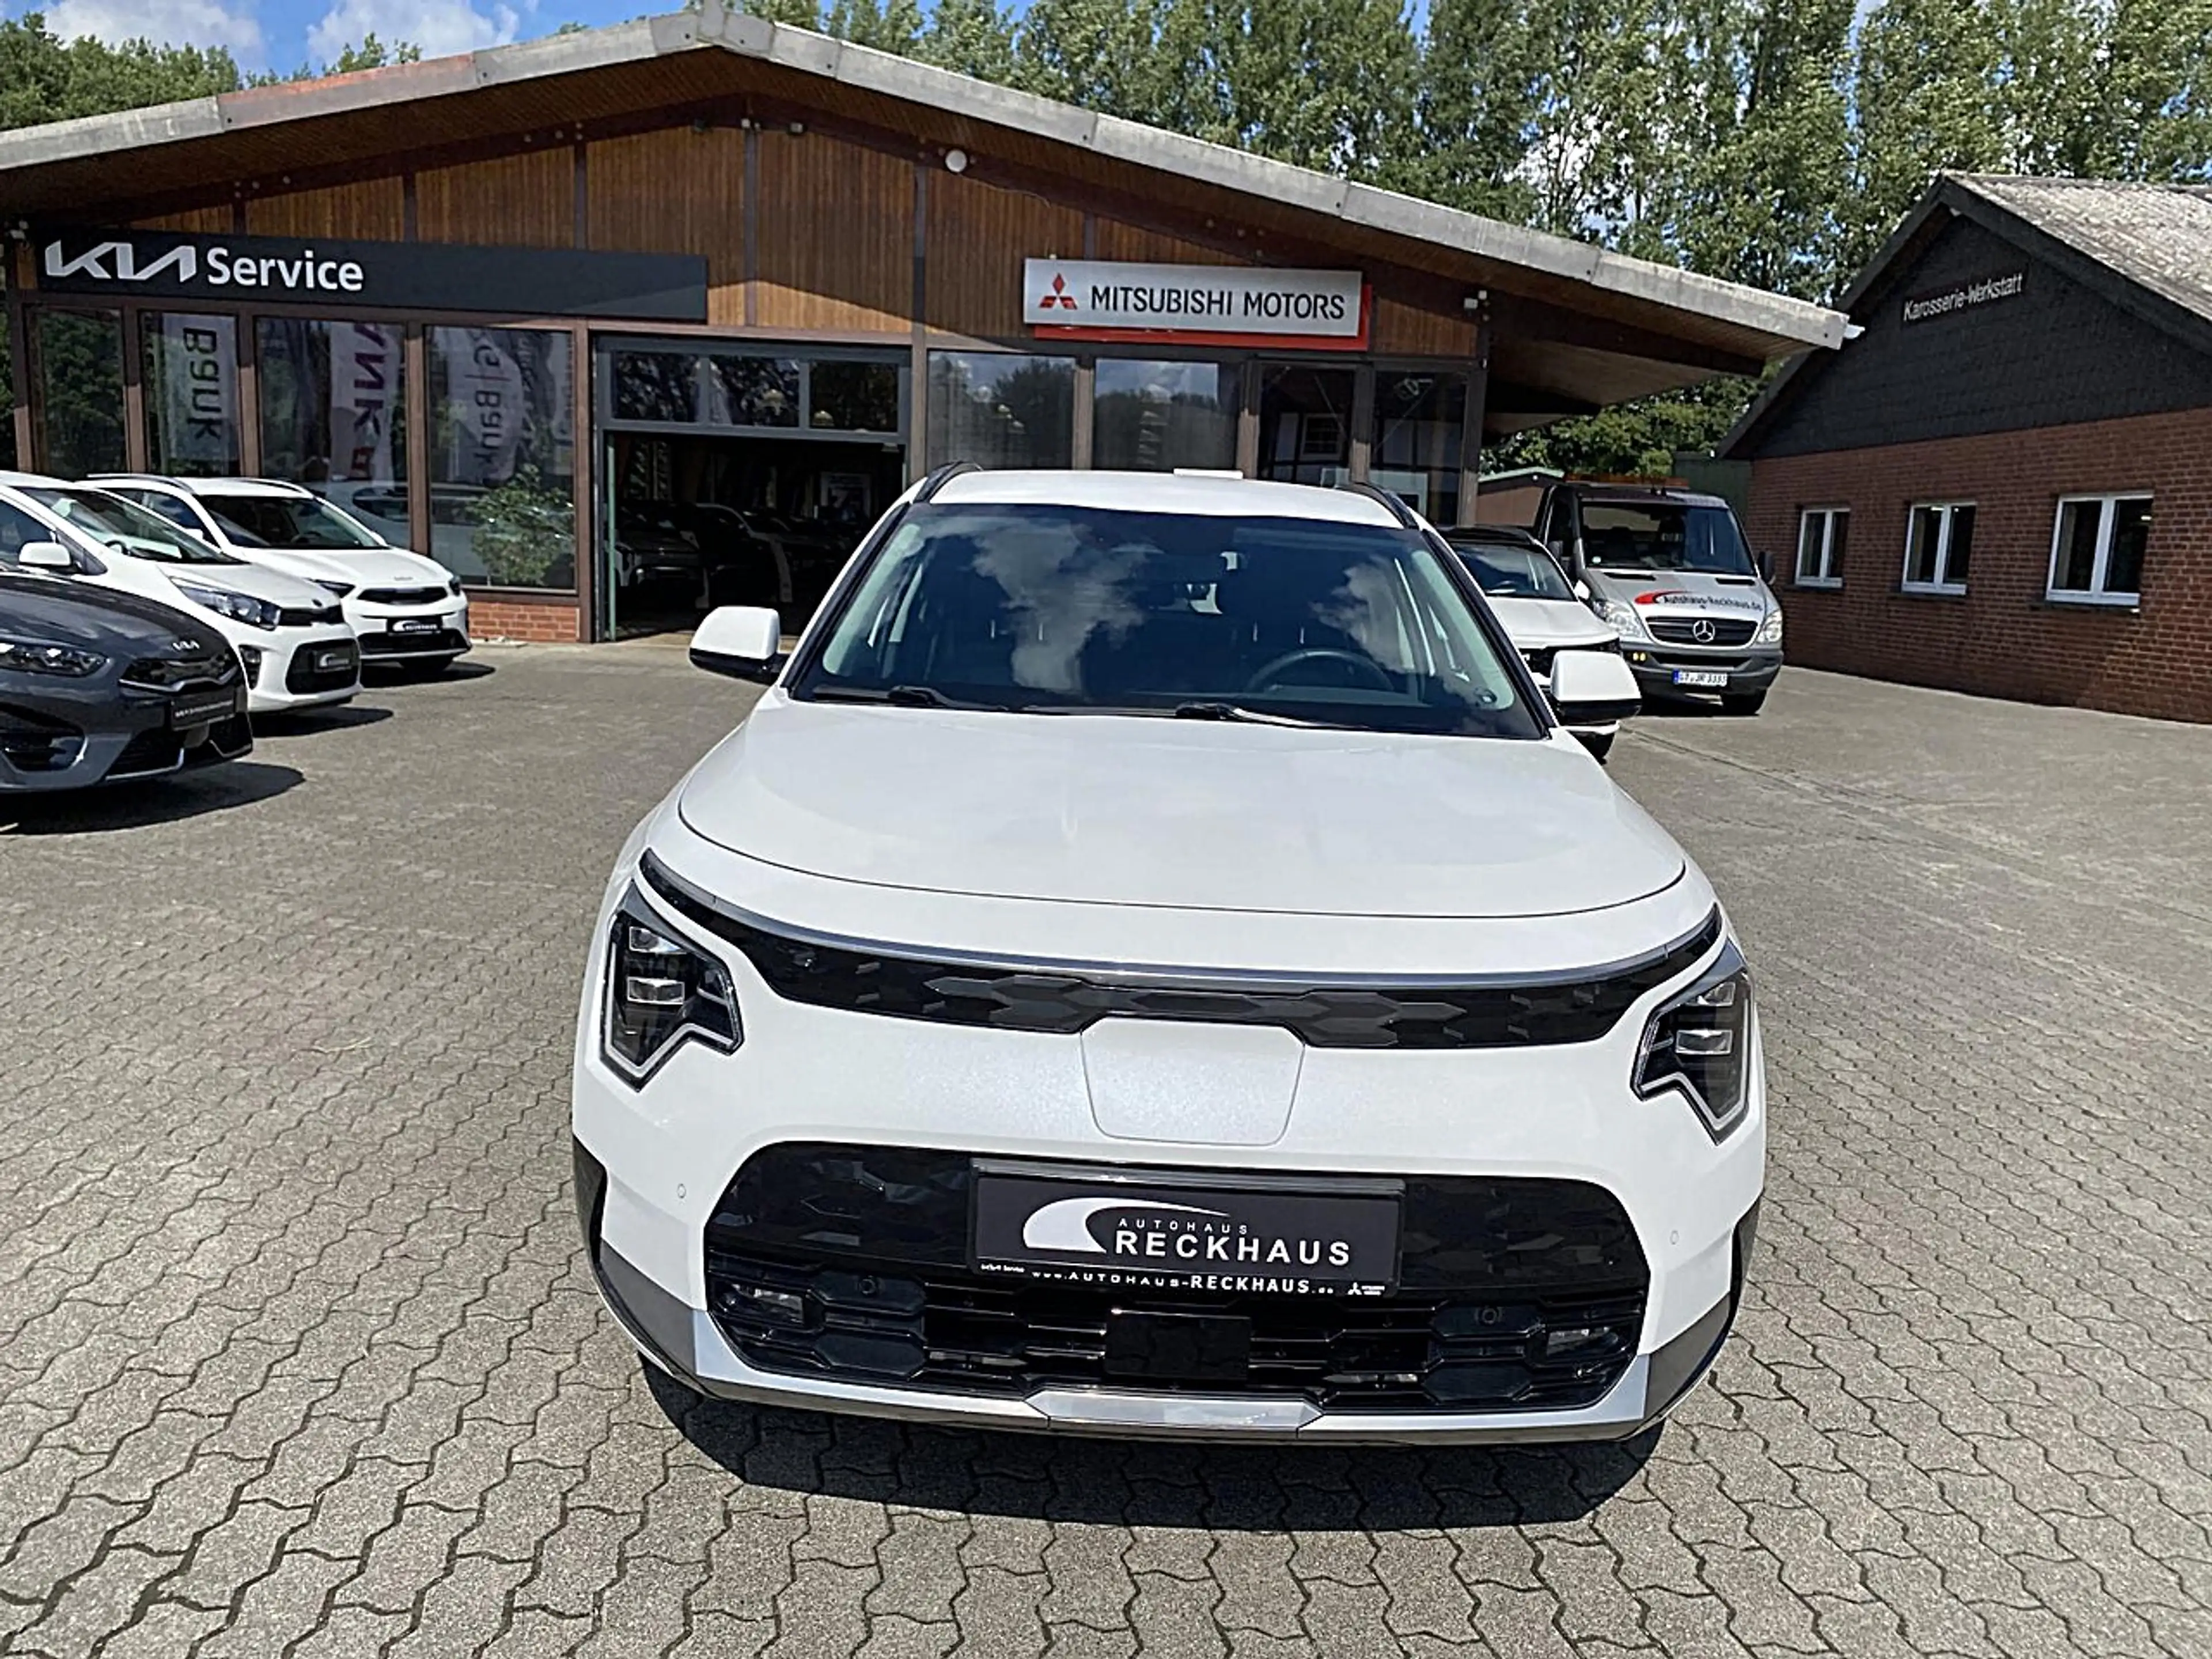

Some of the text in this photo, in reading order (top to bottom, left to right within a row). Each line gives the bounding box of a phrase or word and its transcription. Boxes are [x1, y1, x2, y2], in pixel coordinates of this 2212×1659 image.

[45, 240, 364, 291] KIA Service
[1090, 285, 1345, 320] MITSUBISHI MOTORS
[1903, 272, 2022, 321] Karosserie-Werkstatt
[1118, 1218, 1247, 1234] AUTOHAUS
[1115, 1230, 1349, 1266] RECKHAUS
